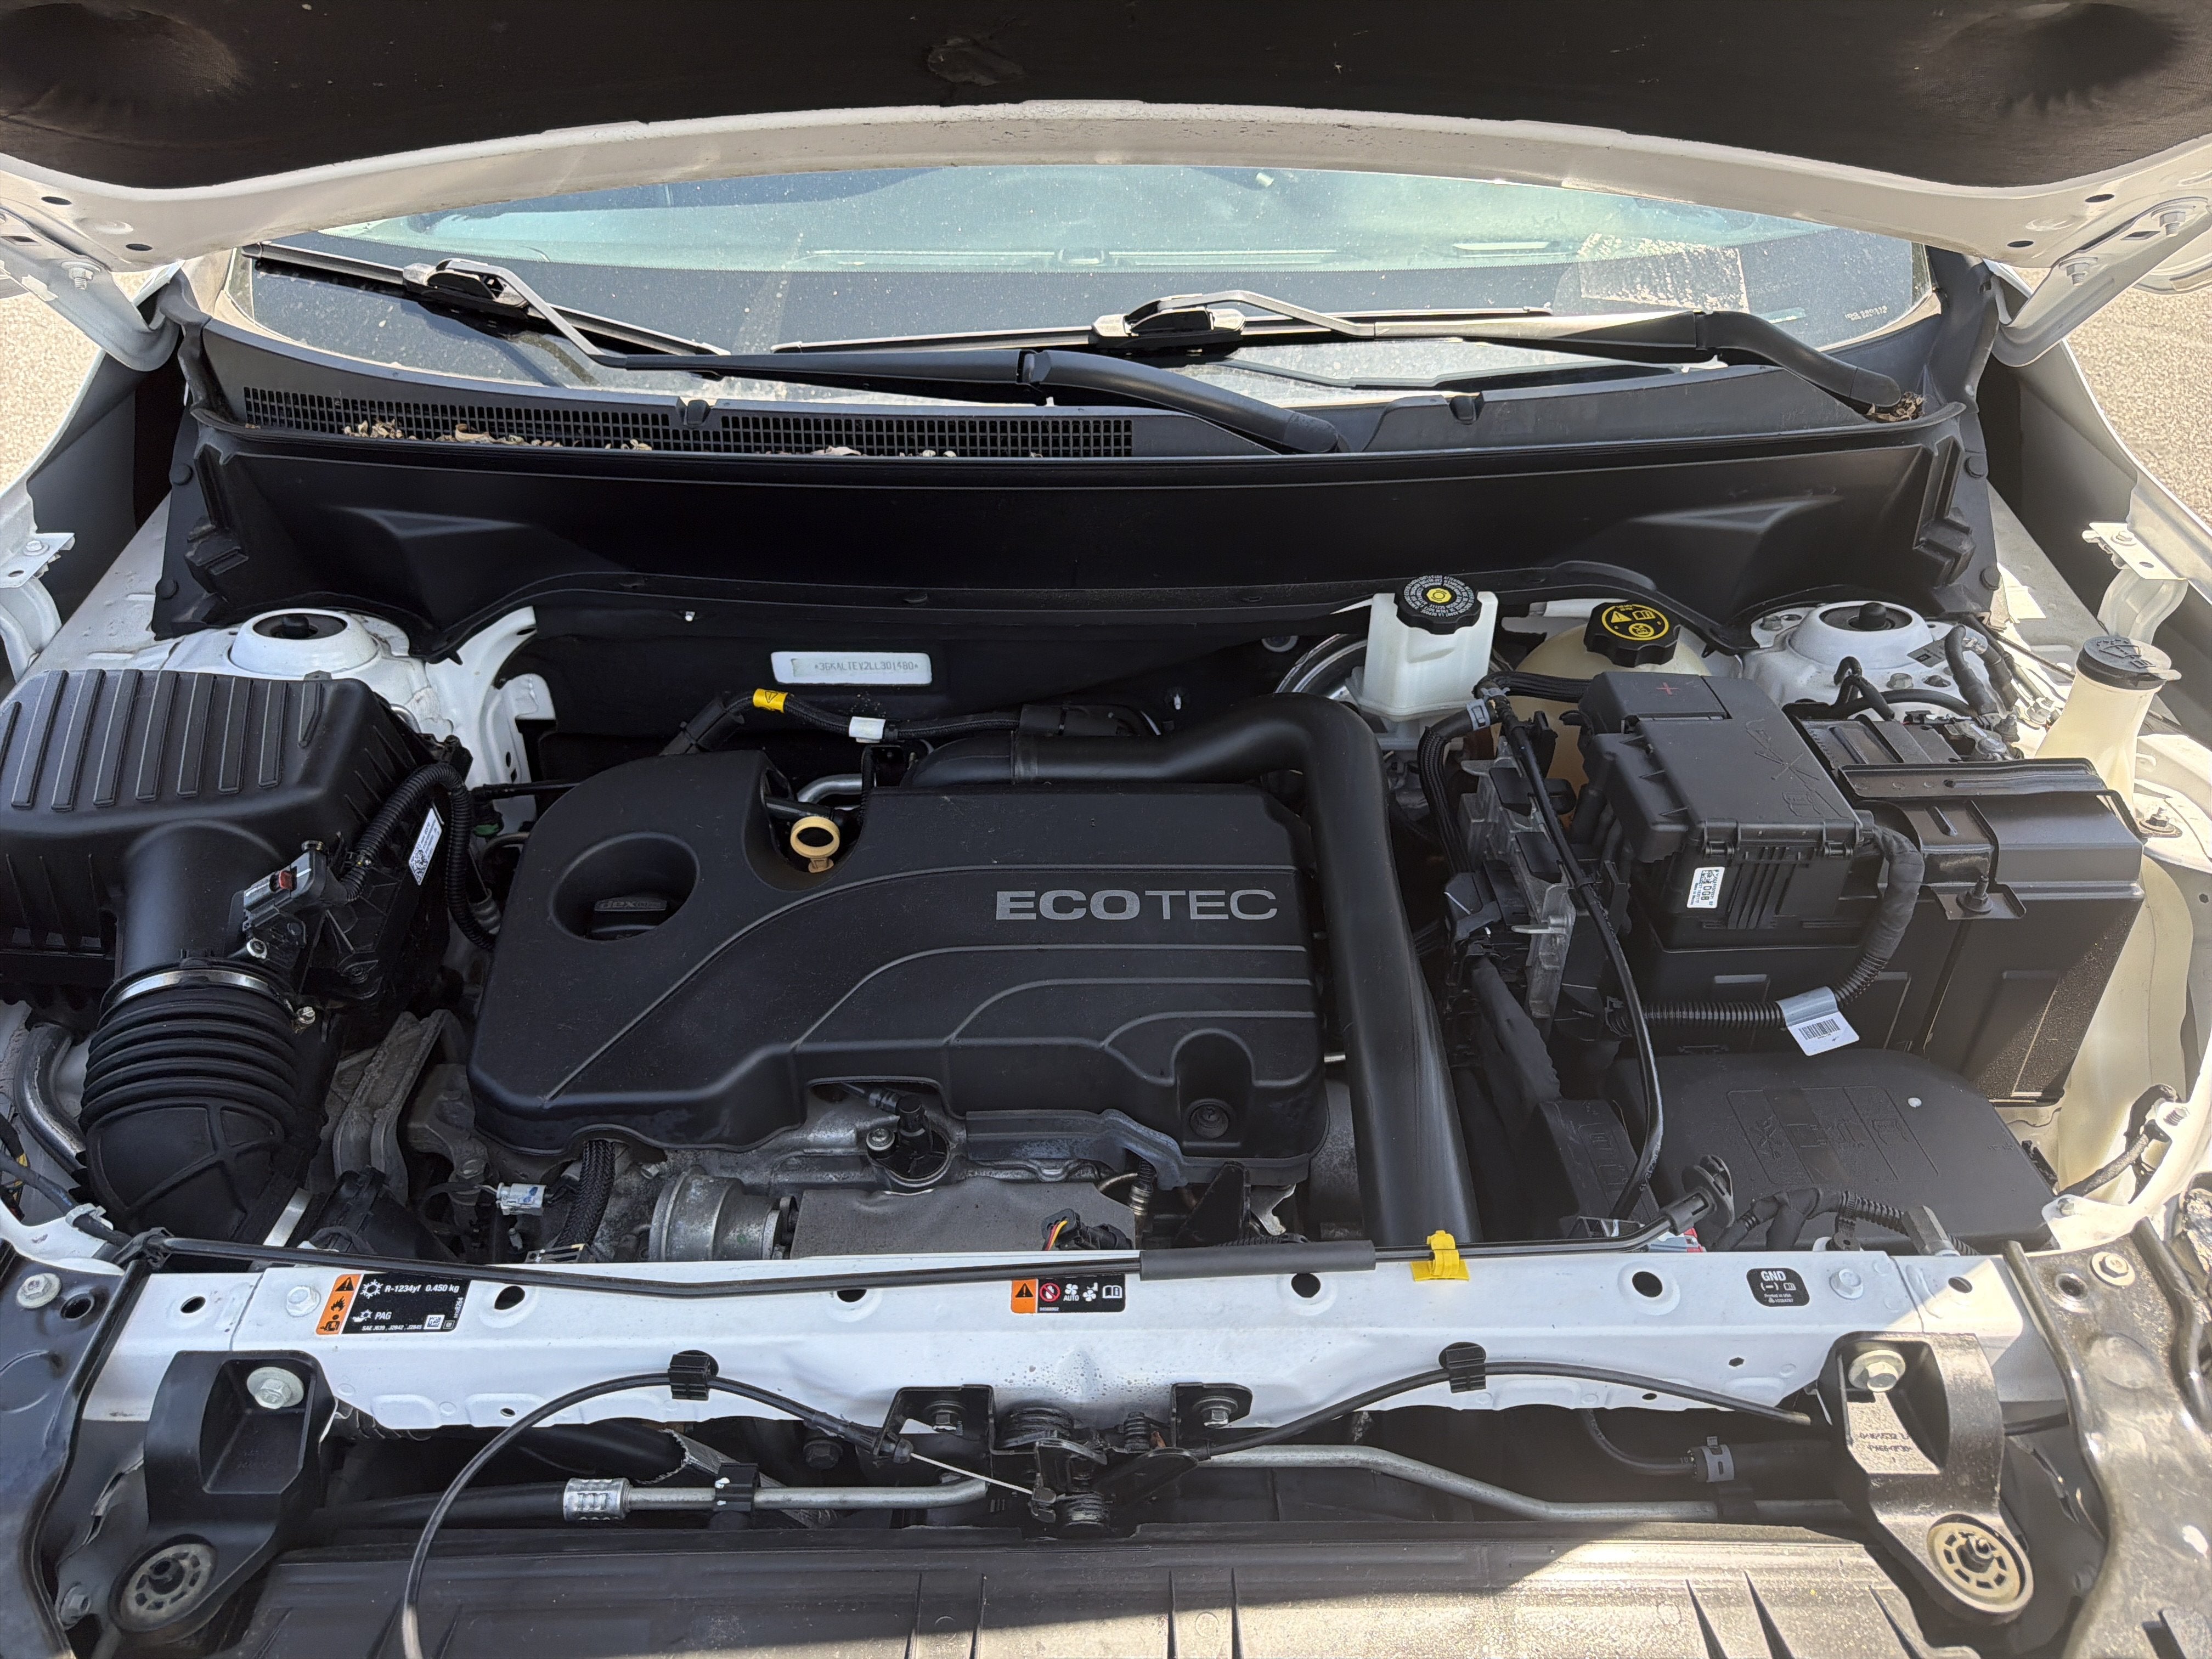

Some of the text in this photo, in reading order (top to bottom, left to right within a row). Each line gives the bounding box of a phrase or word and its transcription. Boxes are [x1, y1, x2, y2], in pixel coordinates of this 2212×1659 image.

[1701, 885, 1712, 901] DGB
[996, 889, 1277, 920] ECOTEC
[1760, 1271, 1786, 1282] GND
[384, 1284, 421, 1293] R-1234yf
[449, 1284, 460, 1293] kg
[375, 1311, 392, 1320] PAG
